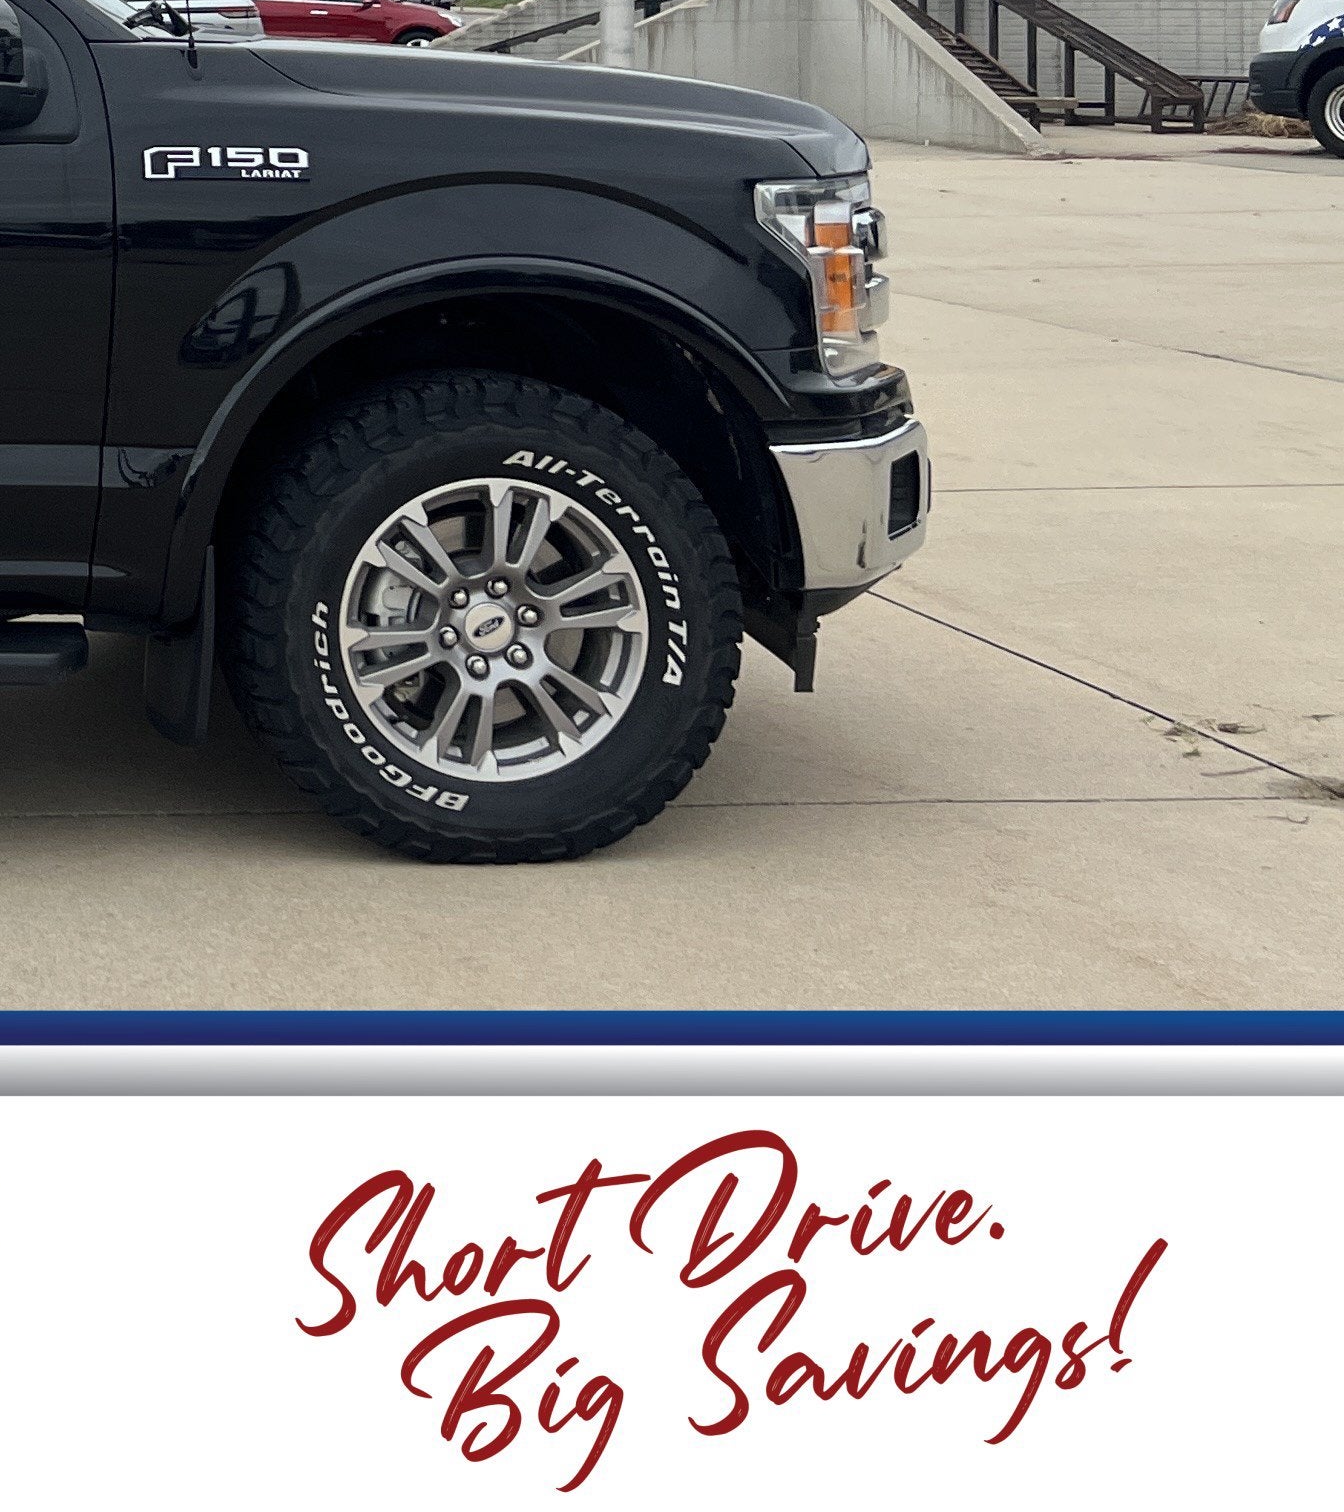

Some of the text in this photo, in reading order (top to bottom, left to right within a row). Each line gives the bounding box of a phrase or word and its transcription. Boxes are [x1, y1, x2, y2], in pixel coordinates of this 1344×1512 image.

[241, 169, 302, 179] LARIAT
[502, 449, 688, 687] All-Terrain T/A
[311, 600, 471, 813] BFGoodrich
